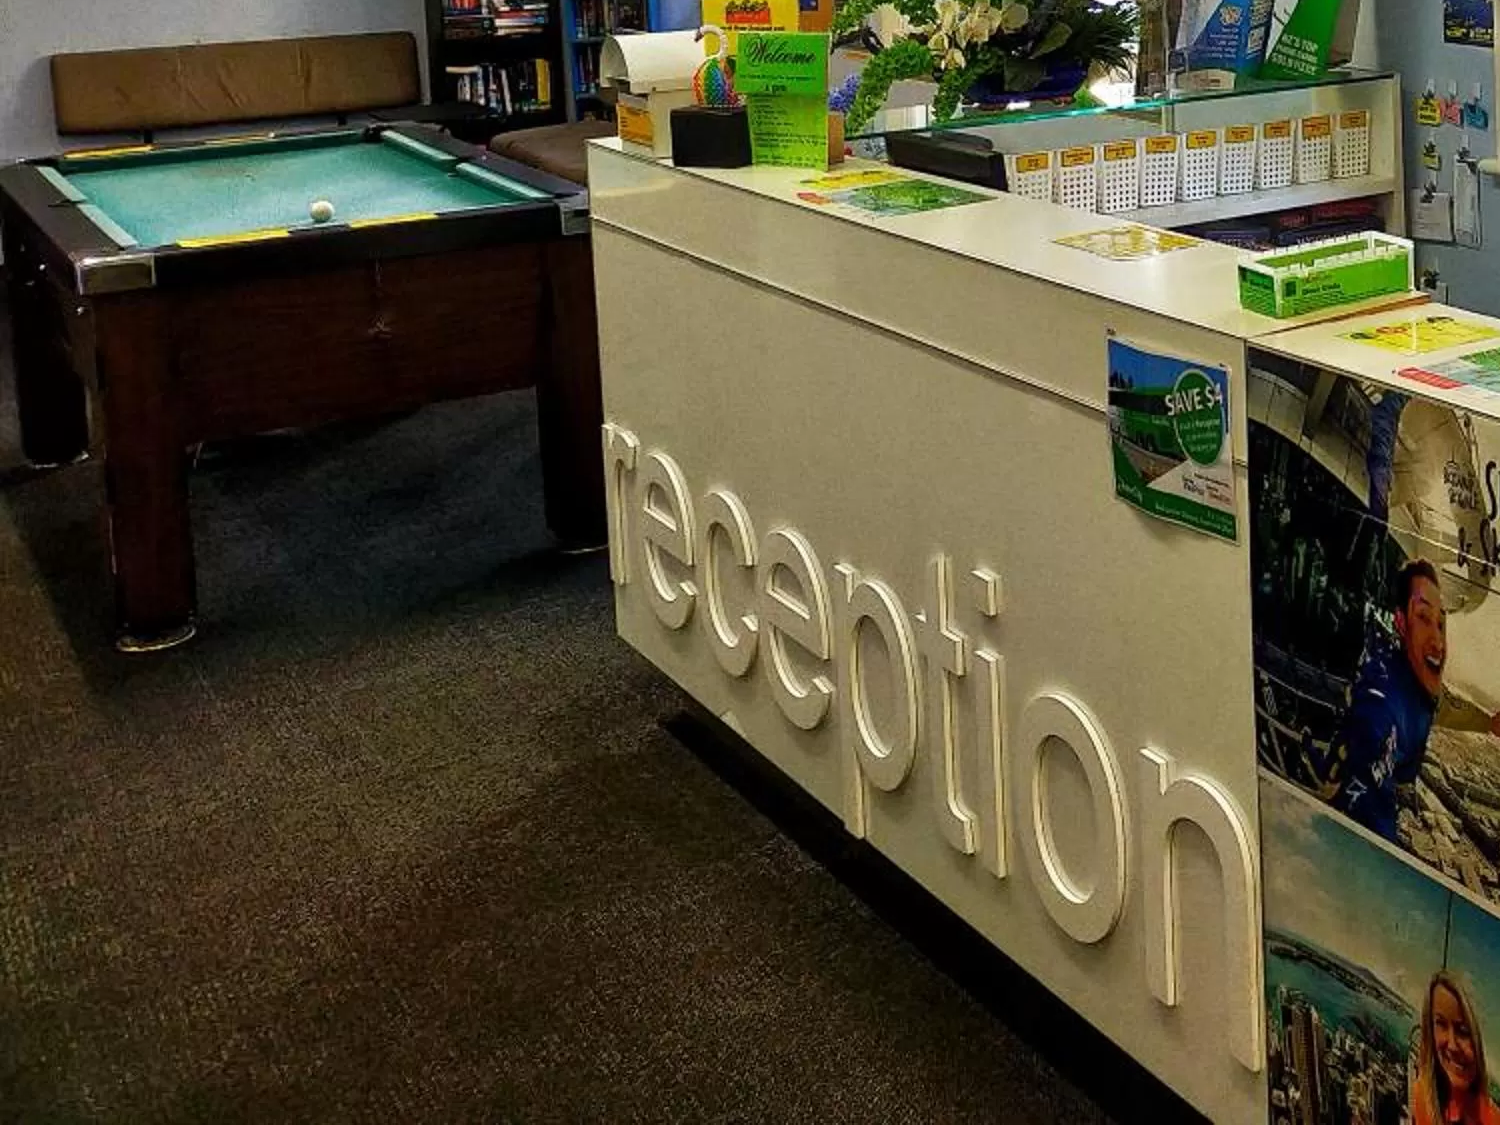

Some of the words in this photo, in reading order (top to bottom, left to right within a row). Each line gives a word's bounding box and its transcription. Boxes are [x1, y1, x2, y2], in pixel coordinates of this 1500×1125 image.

[745, 36, 817, 65] Welcome
[1164, 387, 1205, 416] SAVE
[1205, 382, 1223, 410] $4
[601, 421, 1266, 1072] reception
